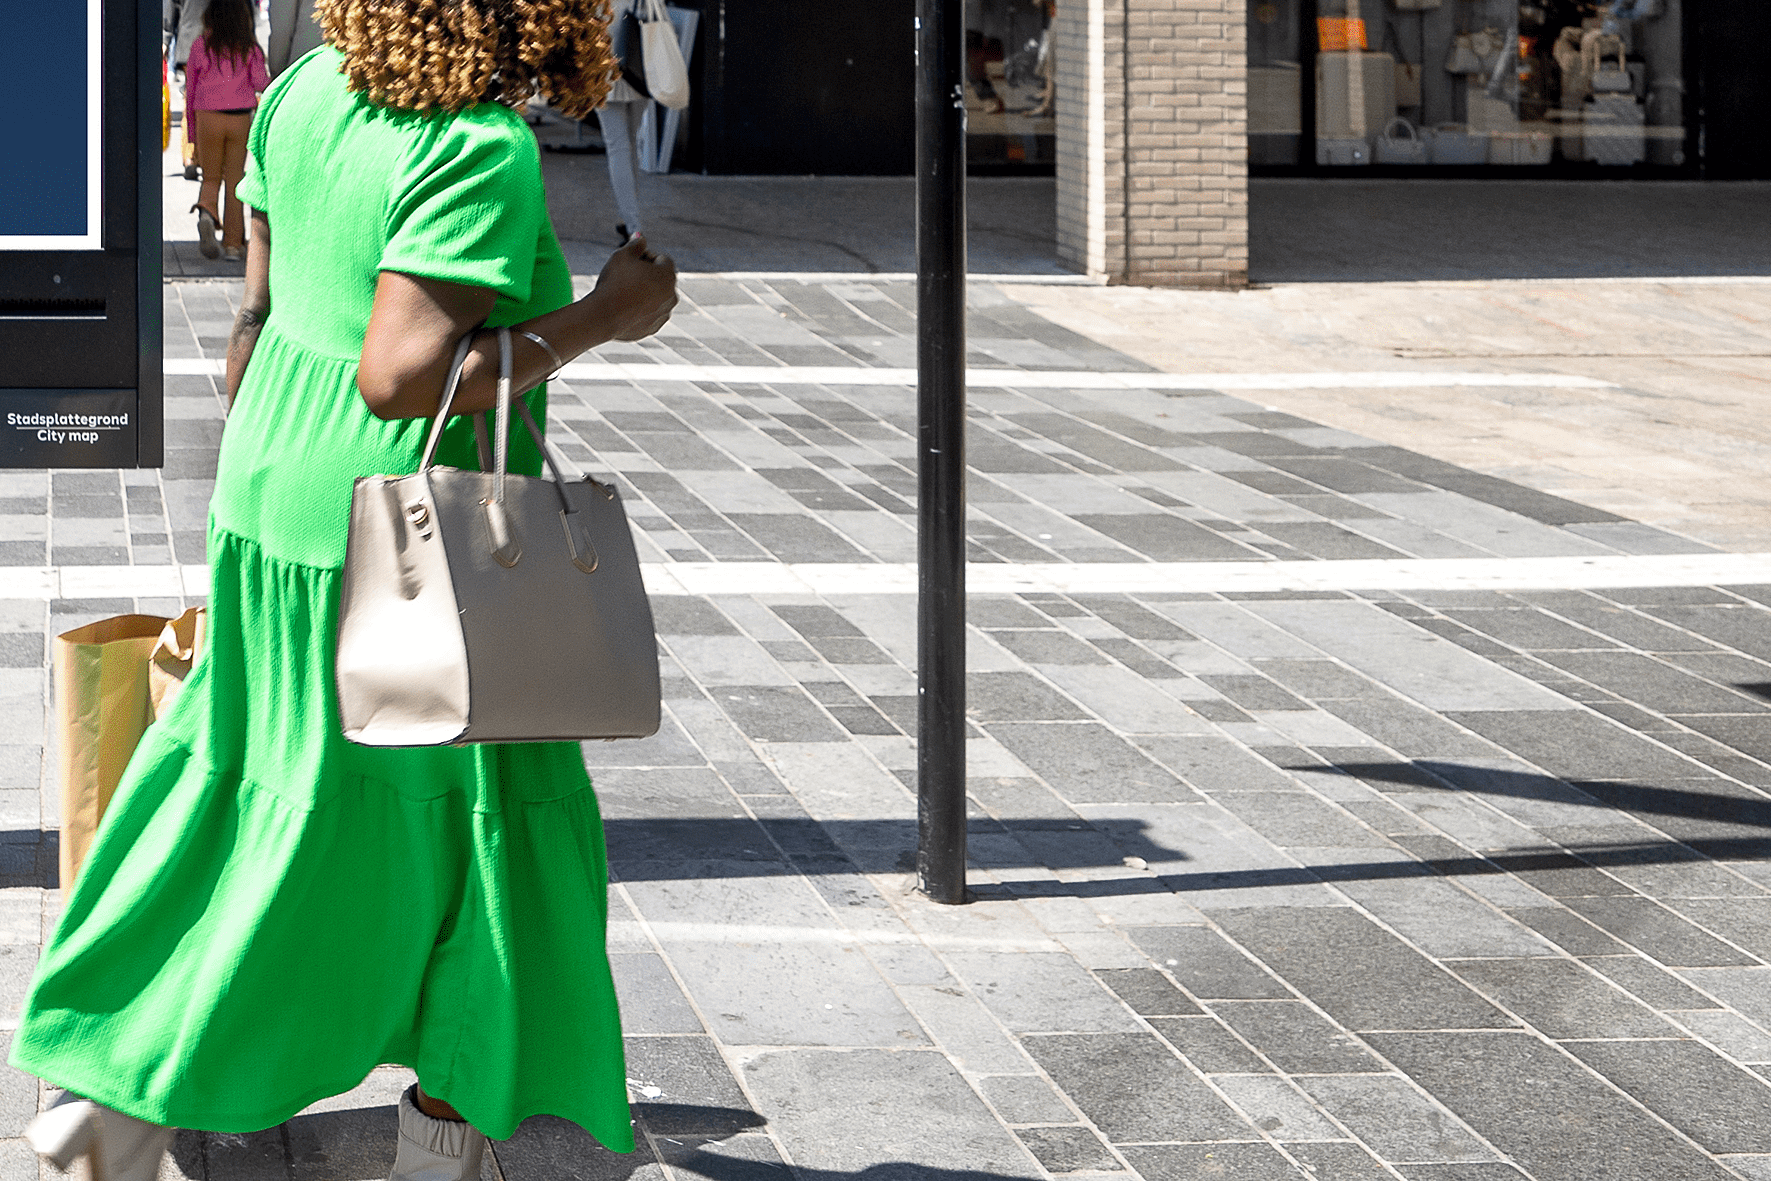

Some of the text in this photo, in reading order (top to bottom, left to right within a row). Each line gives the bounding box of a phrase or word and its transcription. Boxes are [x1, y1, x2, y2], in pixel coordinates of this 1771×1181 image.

[7, 412, 129, 428] Stadsplattegrond
[36, 430, 99, 444] City map
